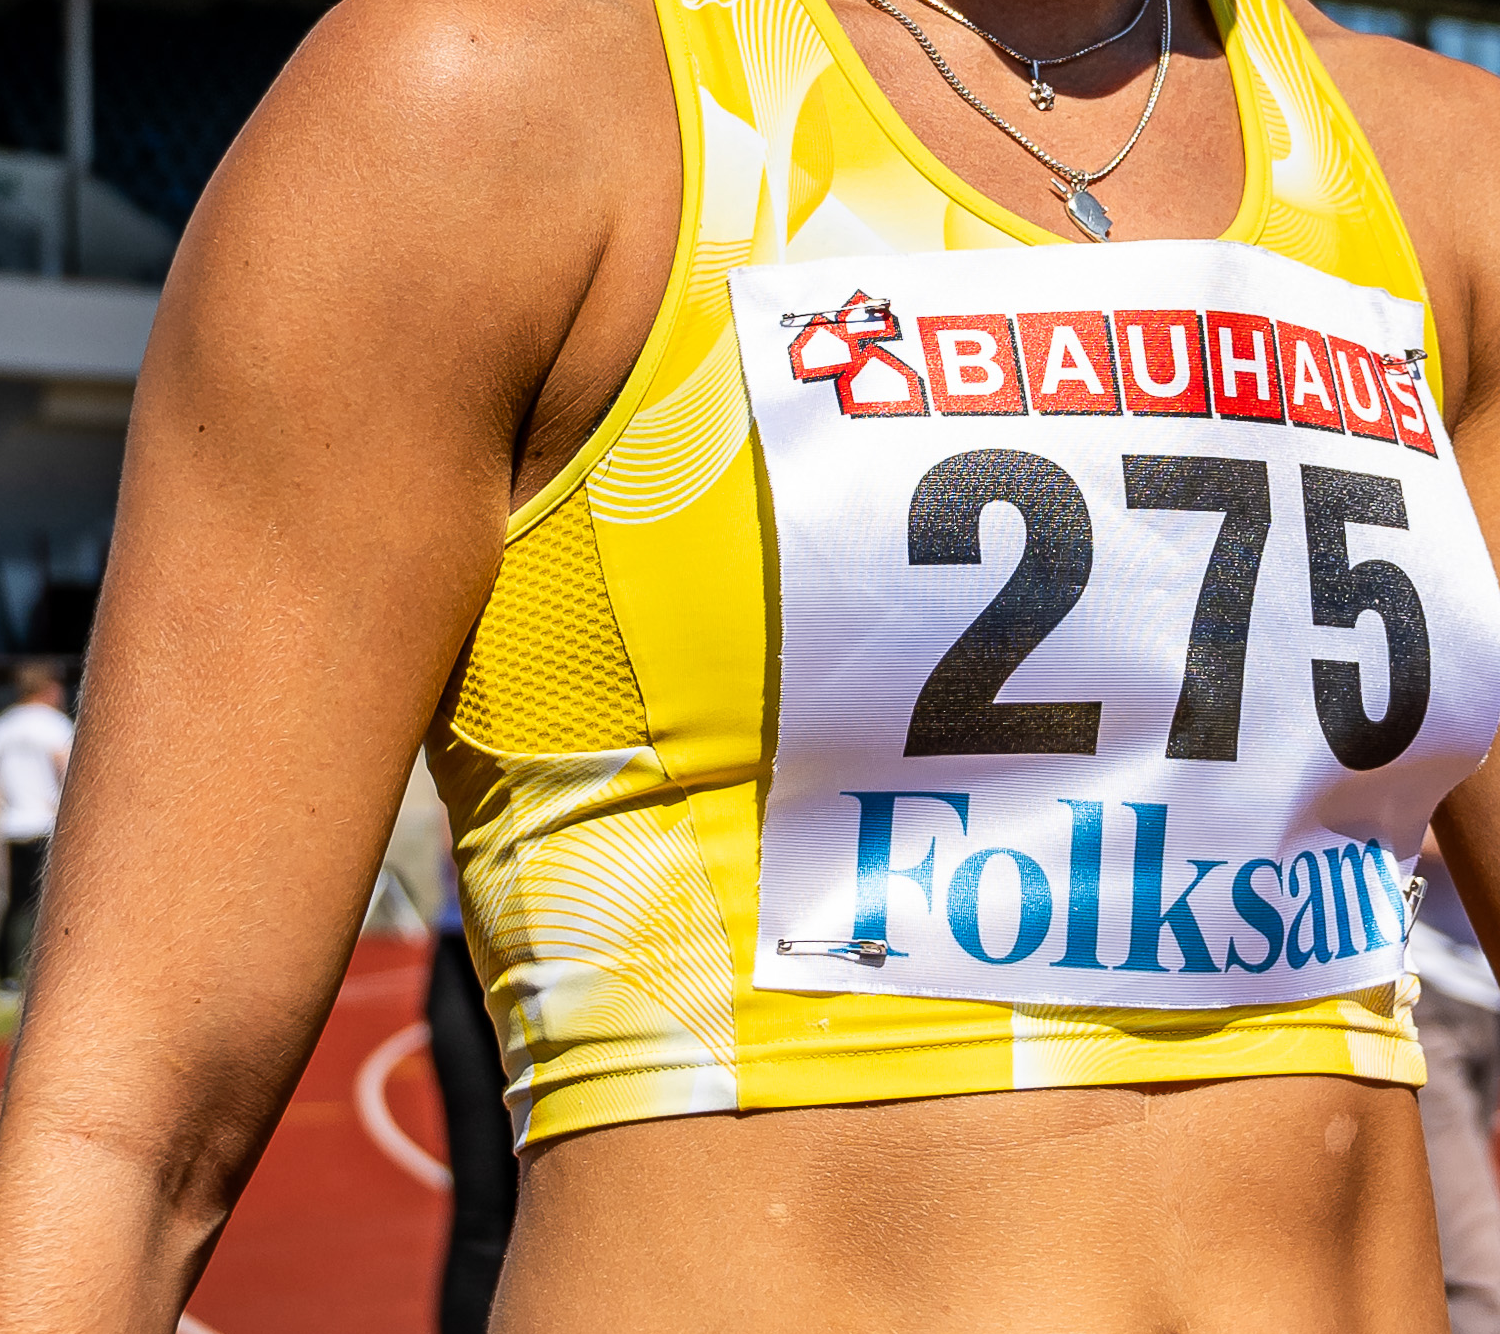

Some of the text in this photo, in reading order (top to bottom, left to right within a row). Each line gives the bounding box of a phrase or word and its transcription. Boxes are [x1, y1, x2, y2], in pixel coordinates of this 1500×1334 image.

[934, 321, 1430, 436] BAUHAUS
[903, 448, 1431, 772] 275
[839, 789, 1407, 974] Folksam
